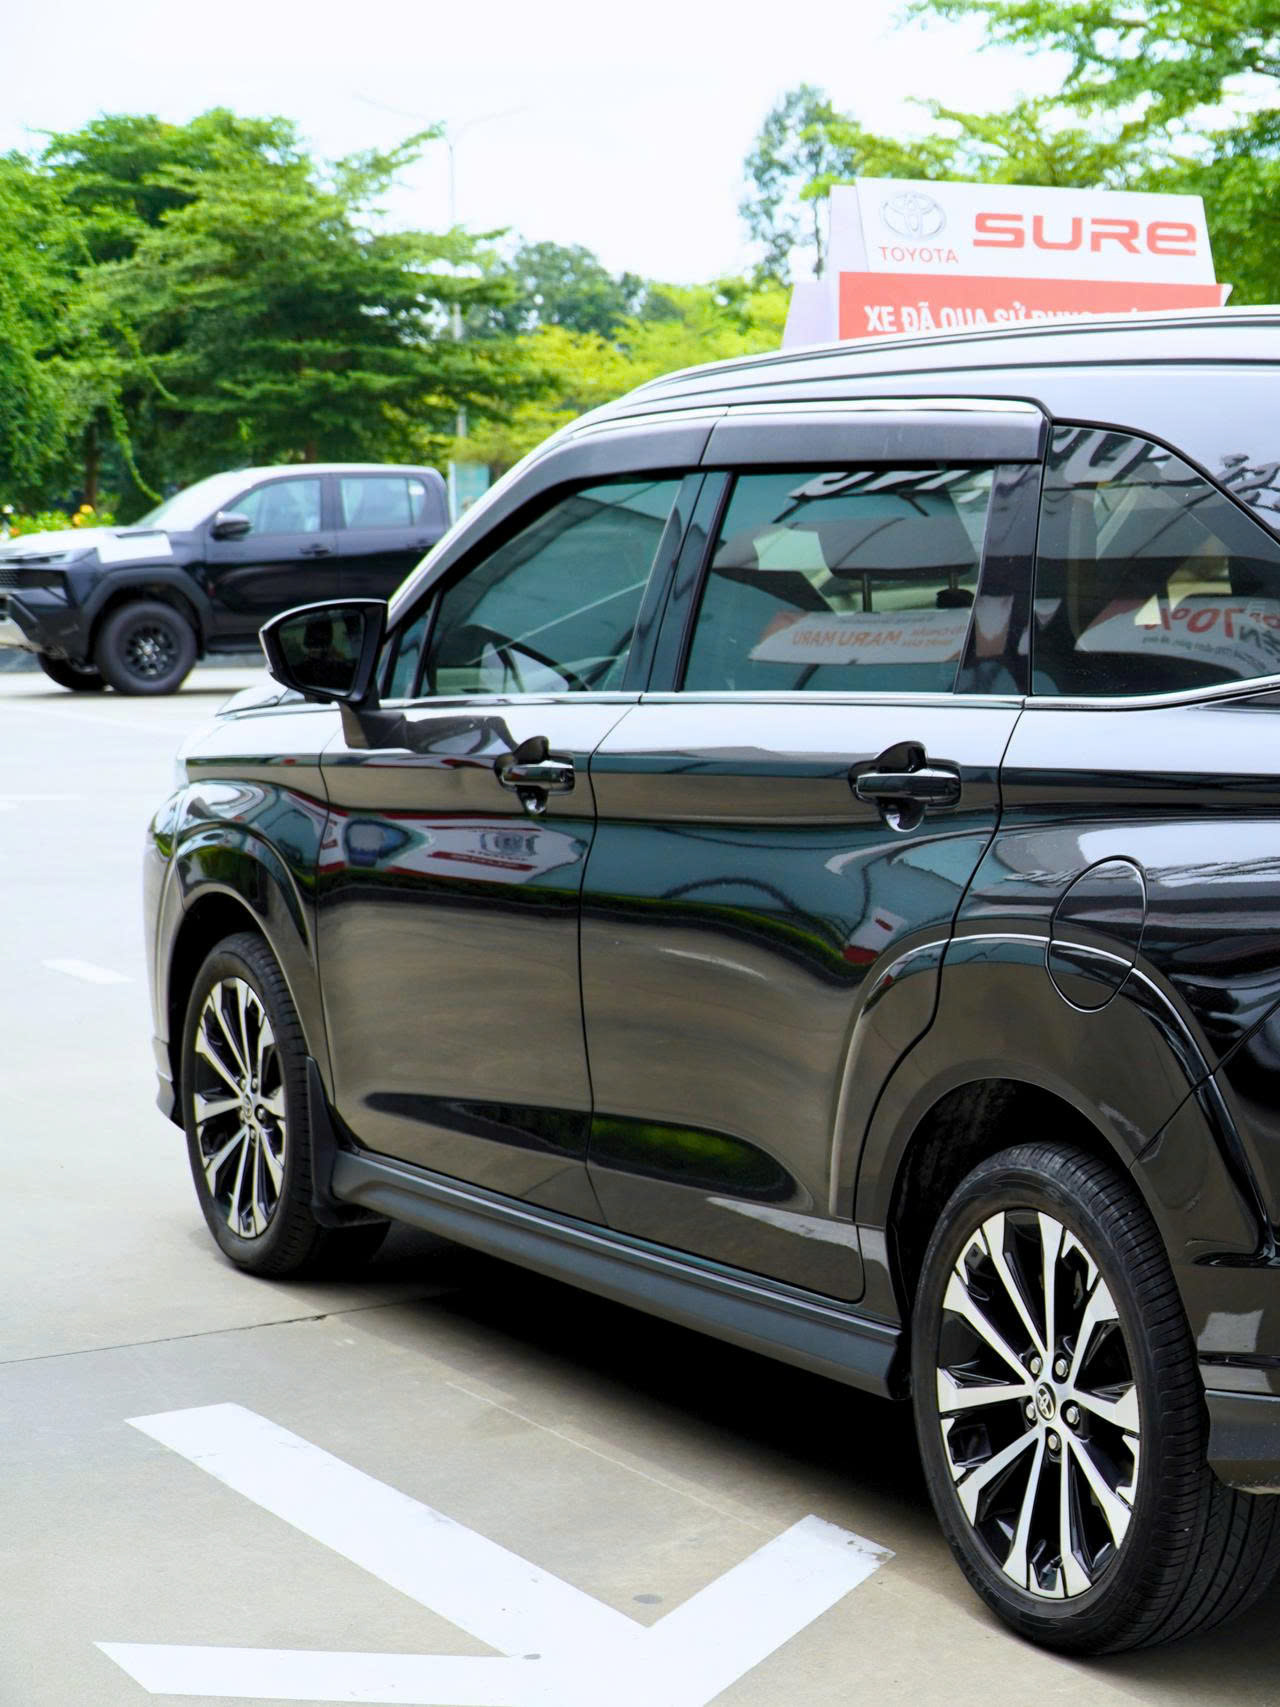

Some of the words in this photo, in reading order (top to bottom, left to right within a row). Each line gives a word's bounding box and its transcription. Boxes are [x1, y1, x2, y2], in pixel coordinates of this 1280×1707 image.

[879, 246, 959, 263] TOYOTA
[864, 305, 897, 332] XE
[901, 301, 938, 333] ĐÃ
[940, 307, 989, 329] QUA
